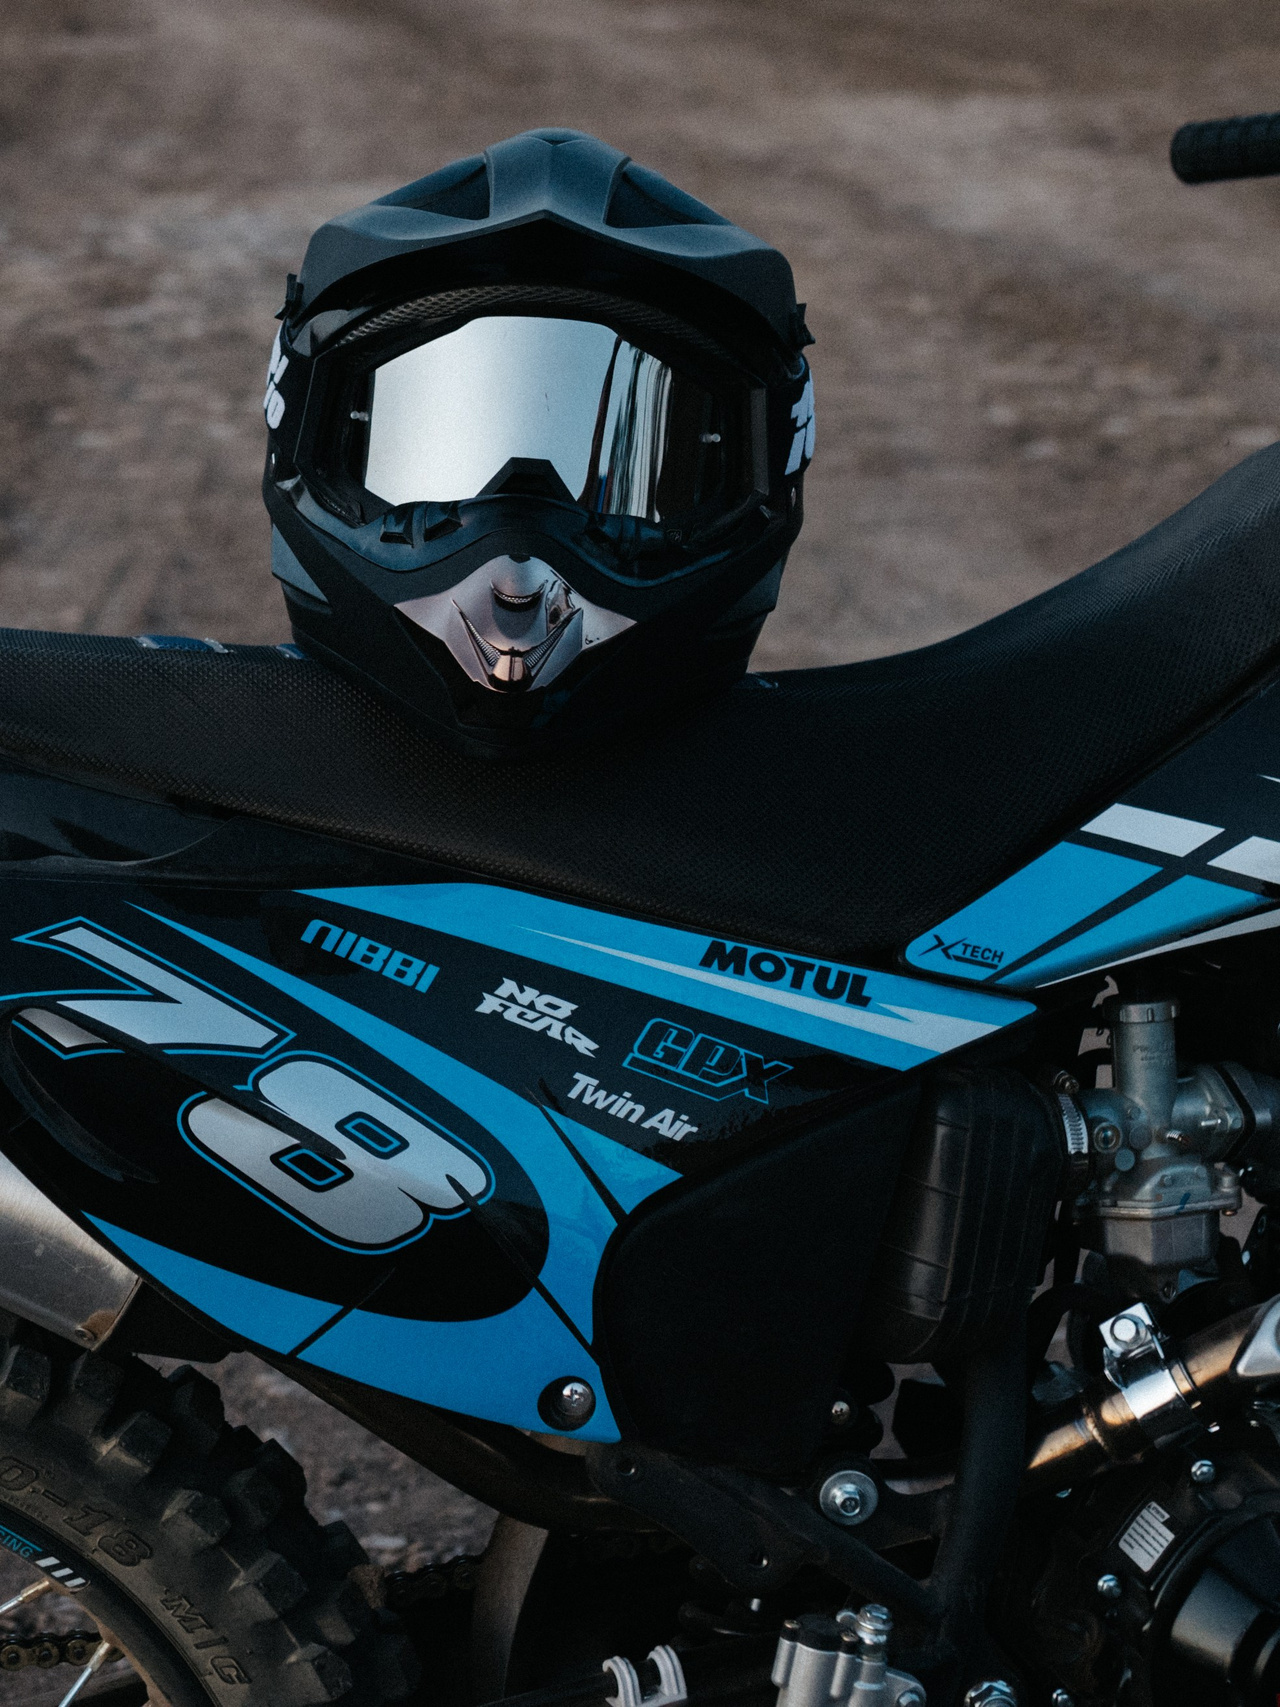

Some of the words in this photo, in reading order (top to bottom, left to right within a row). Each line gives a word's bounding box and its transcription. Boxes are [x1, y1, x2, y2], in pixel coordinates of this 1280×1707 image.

[300, 919, 440, 994] NIBBI
[698, 940, 873, 1008] MOTUL
[474, 992, 600, 1059] FEAR
[493, 977, 579, 1020] NO
[622, 1018, 794, 1104] GPX
[567, 1072, 646, 1123] Twin
[641, 1106, 699, 1142] Air
